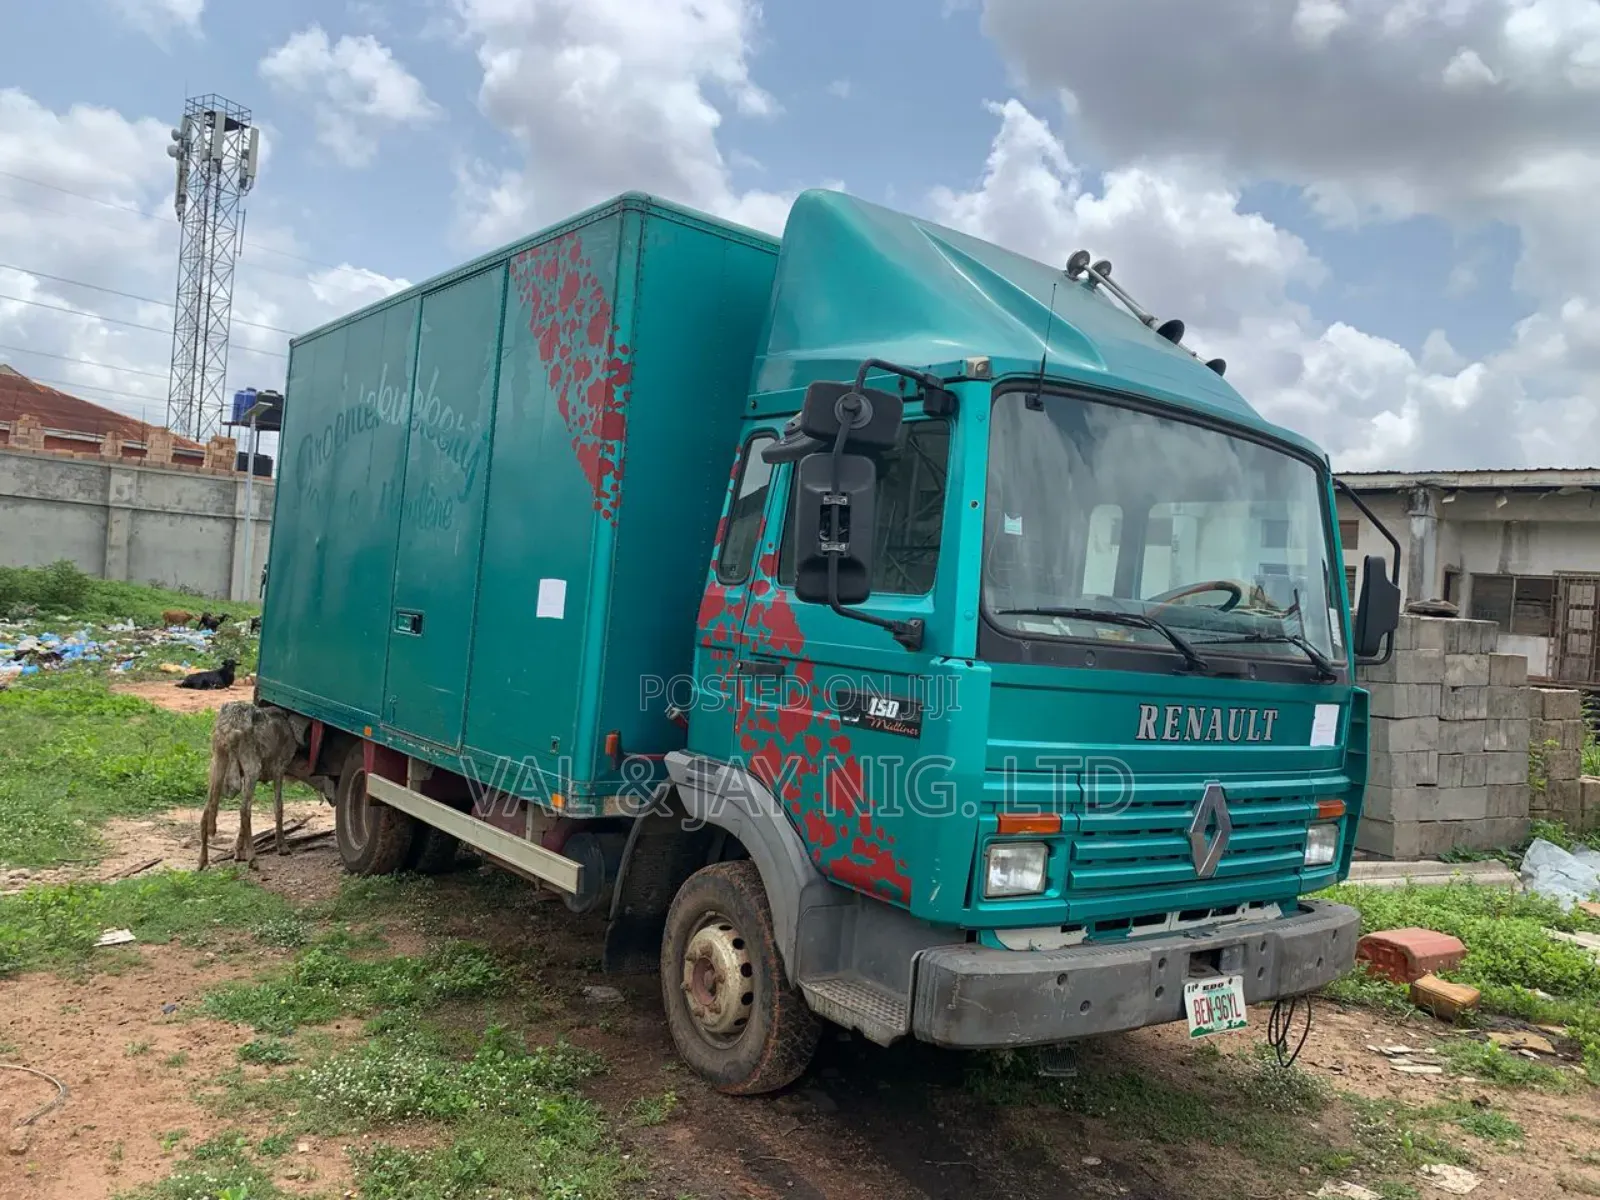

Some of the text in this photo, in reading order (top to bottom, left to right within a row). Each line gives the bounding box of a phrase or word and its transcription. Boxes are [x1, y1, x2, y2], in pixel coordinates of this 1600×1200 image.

[868, 697, 899, 718] 150
[866, 716, 918, 735] Midliner
[1135, 703, 1279, 742] RENAULT
